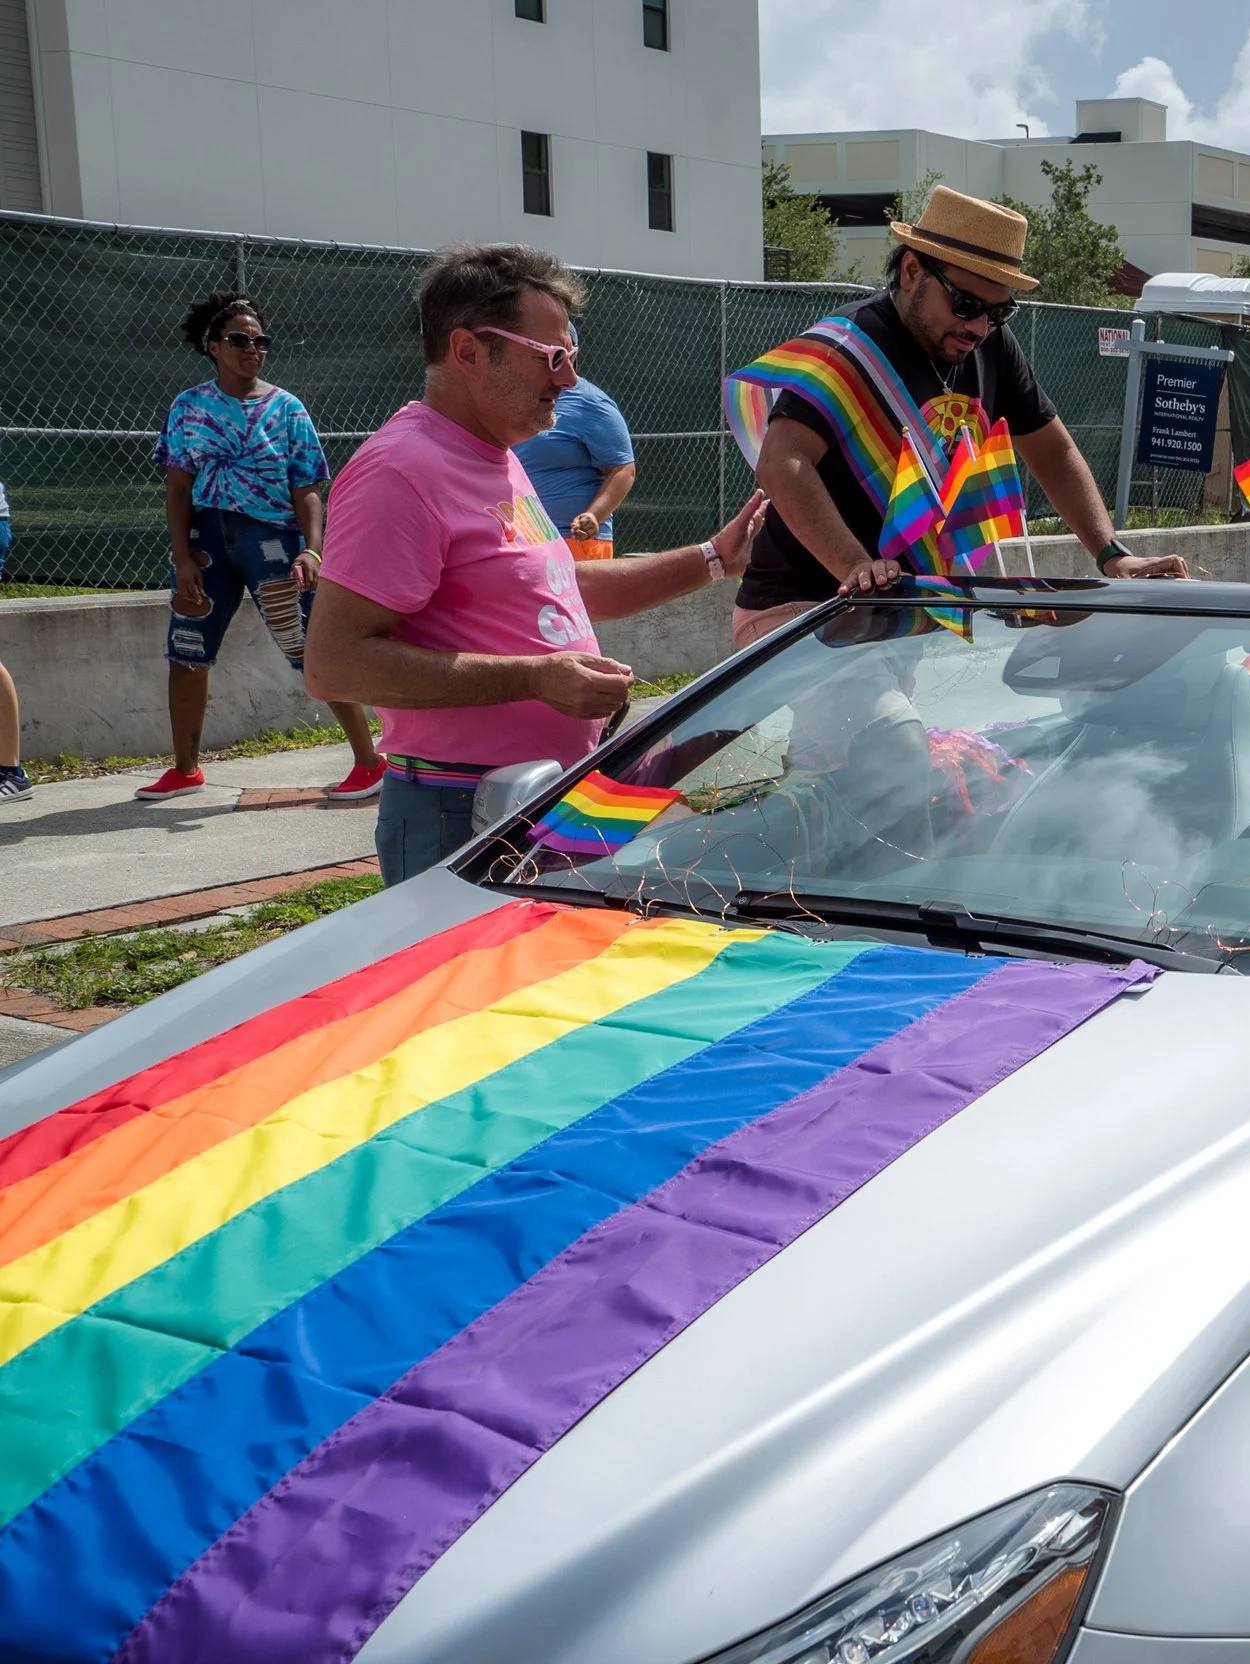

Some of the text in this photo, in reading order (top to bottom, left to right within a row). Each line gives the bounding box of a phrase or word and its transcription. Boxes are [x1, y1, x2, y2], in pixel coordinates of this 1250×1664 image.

[1157, 374, 1197, 389] Premier
[1155, 397, 1206, 415] Sotheby's
[1154, 411, 1187, 420] INTERNATIONAL
[1152, 426, 1197, 438] Frank Lambert
[1151, 437, 1202, 451] 941.920.1500
[483, 495, 559, 552] PROU
